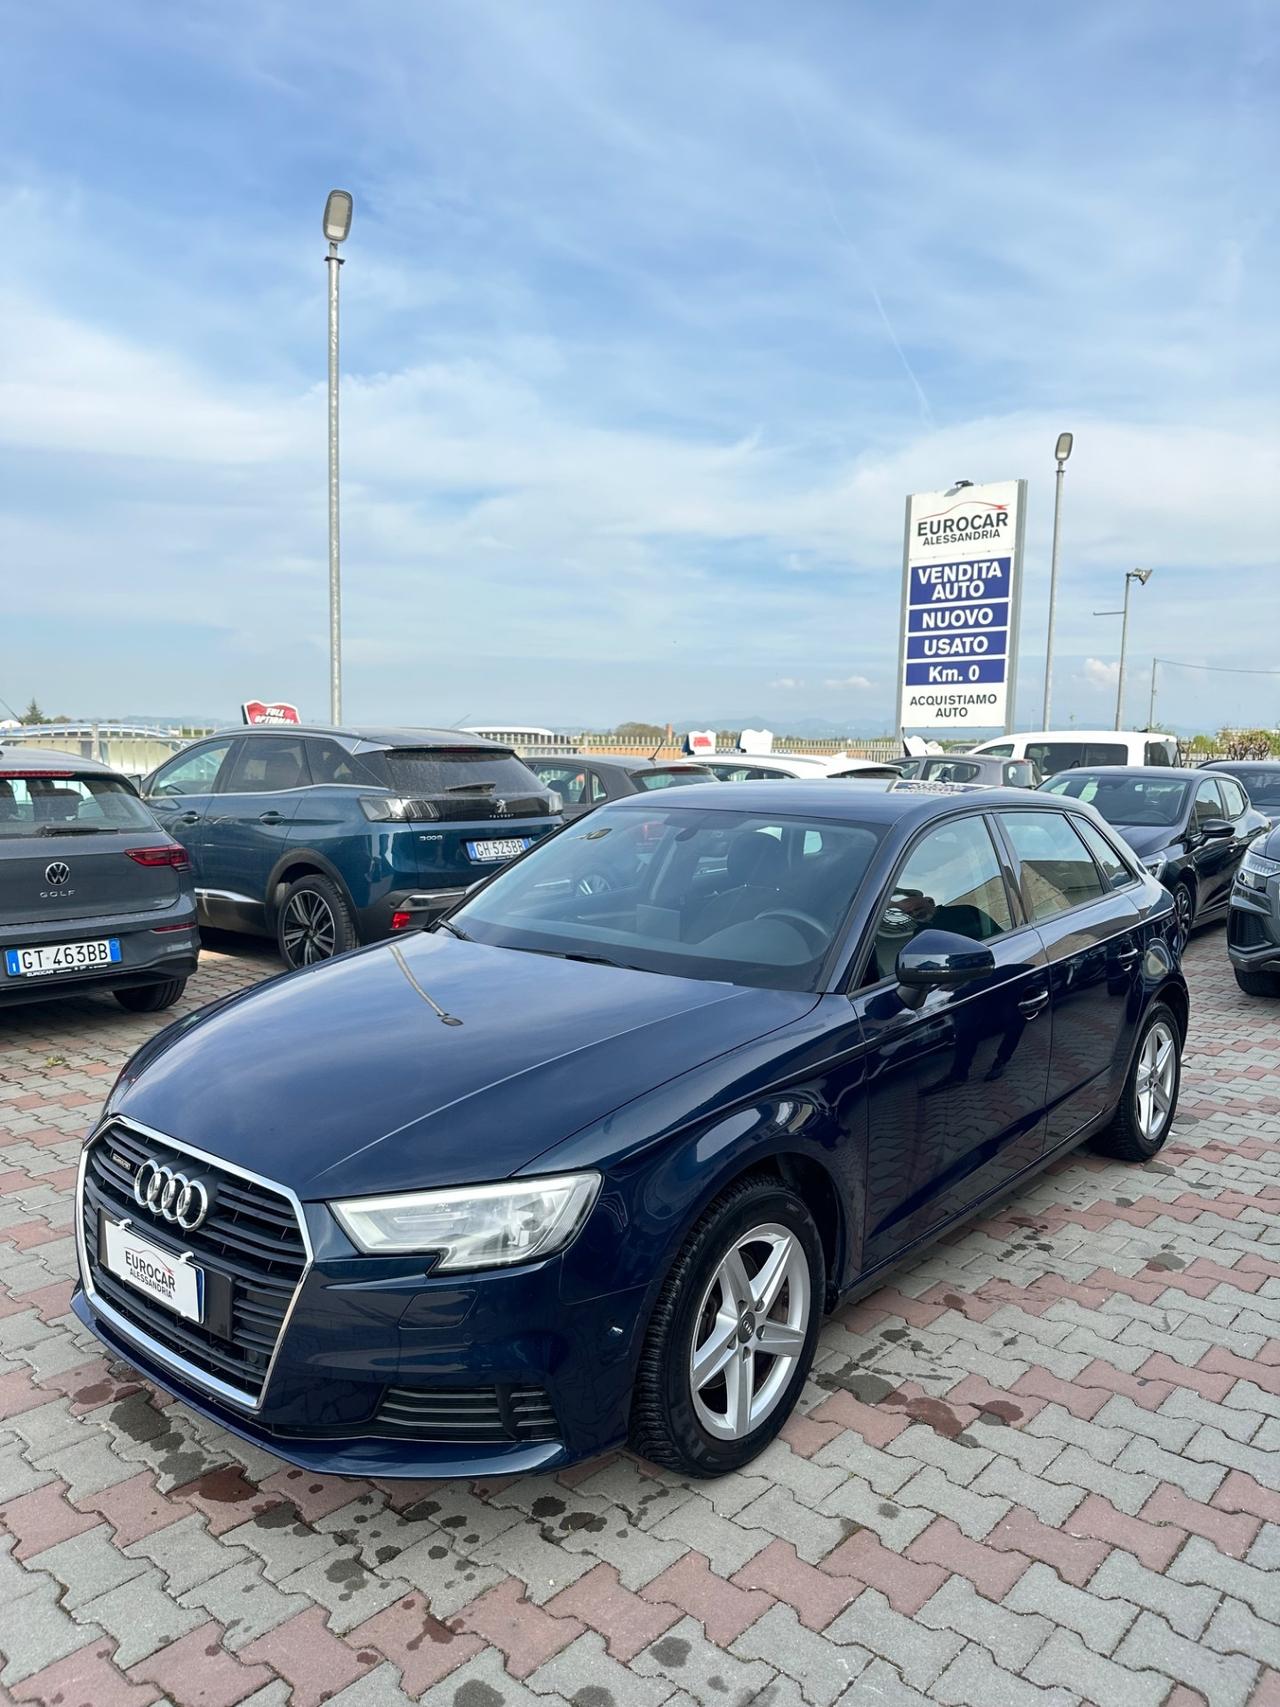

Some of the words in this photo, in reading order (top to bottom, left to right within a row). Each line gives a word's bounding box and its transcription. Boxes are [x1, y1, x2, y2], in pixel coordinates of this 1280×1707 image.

[917, 511, 1009, 537] EUROCAR
[922, 528, 1001, 547] ALESSANDRIA
[917, 560, 1003, 585] VENDITA
[931, 580, 985, 601] AUTO
[922, 607, 994, 629] NUOVO
[923, 636, 989, 656] USATO
[928, 665, 963, 683] Km.
[968, 664, 980, 681] 0
[909, 693, 998, 707] ACQUISTIAMO
[935, 706, 969, 718] AUTO
[476, 842, 490, 857] GH
[493, 839, 525, 855] 523BB
[39, 889, 76, 898] GOLF
[22, 949, 44, 970] GT
[52, 942, 108, 967] 463BB
[125, 1250, 176, 1292] EUROCAR
[130, 1267, 173, 1299] ALESSANDRIA
